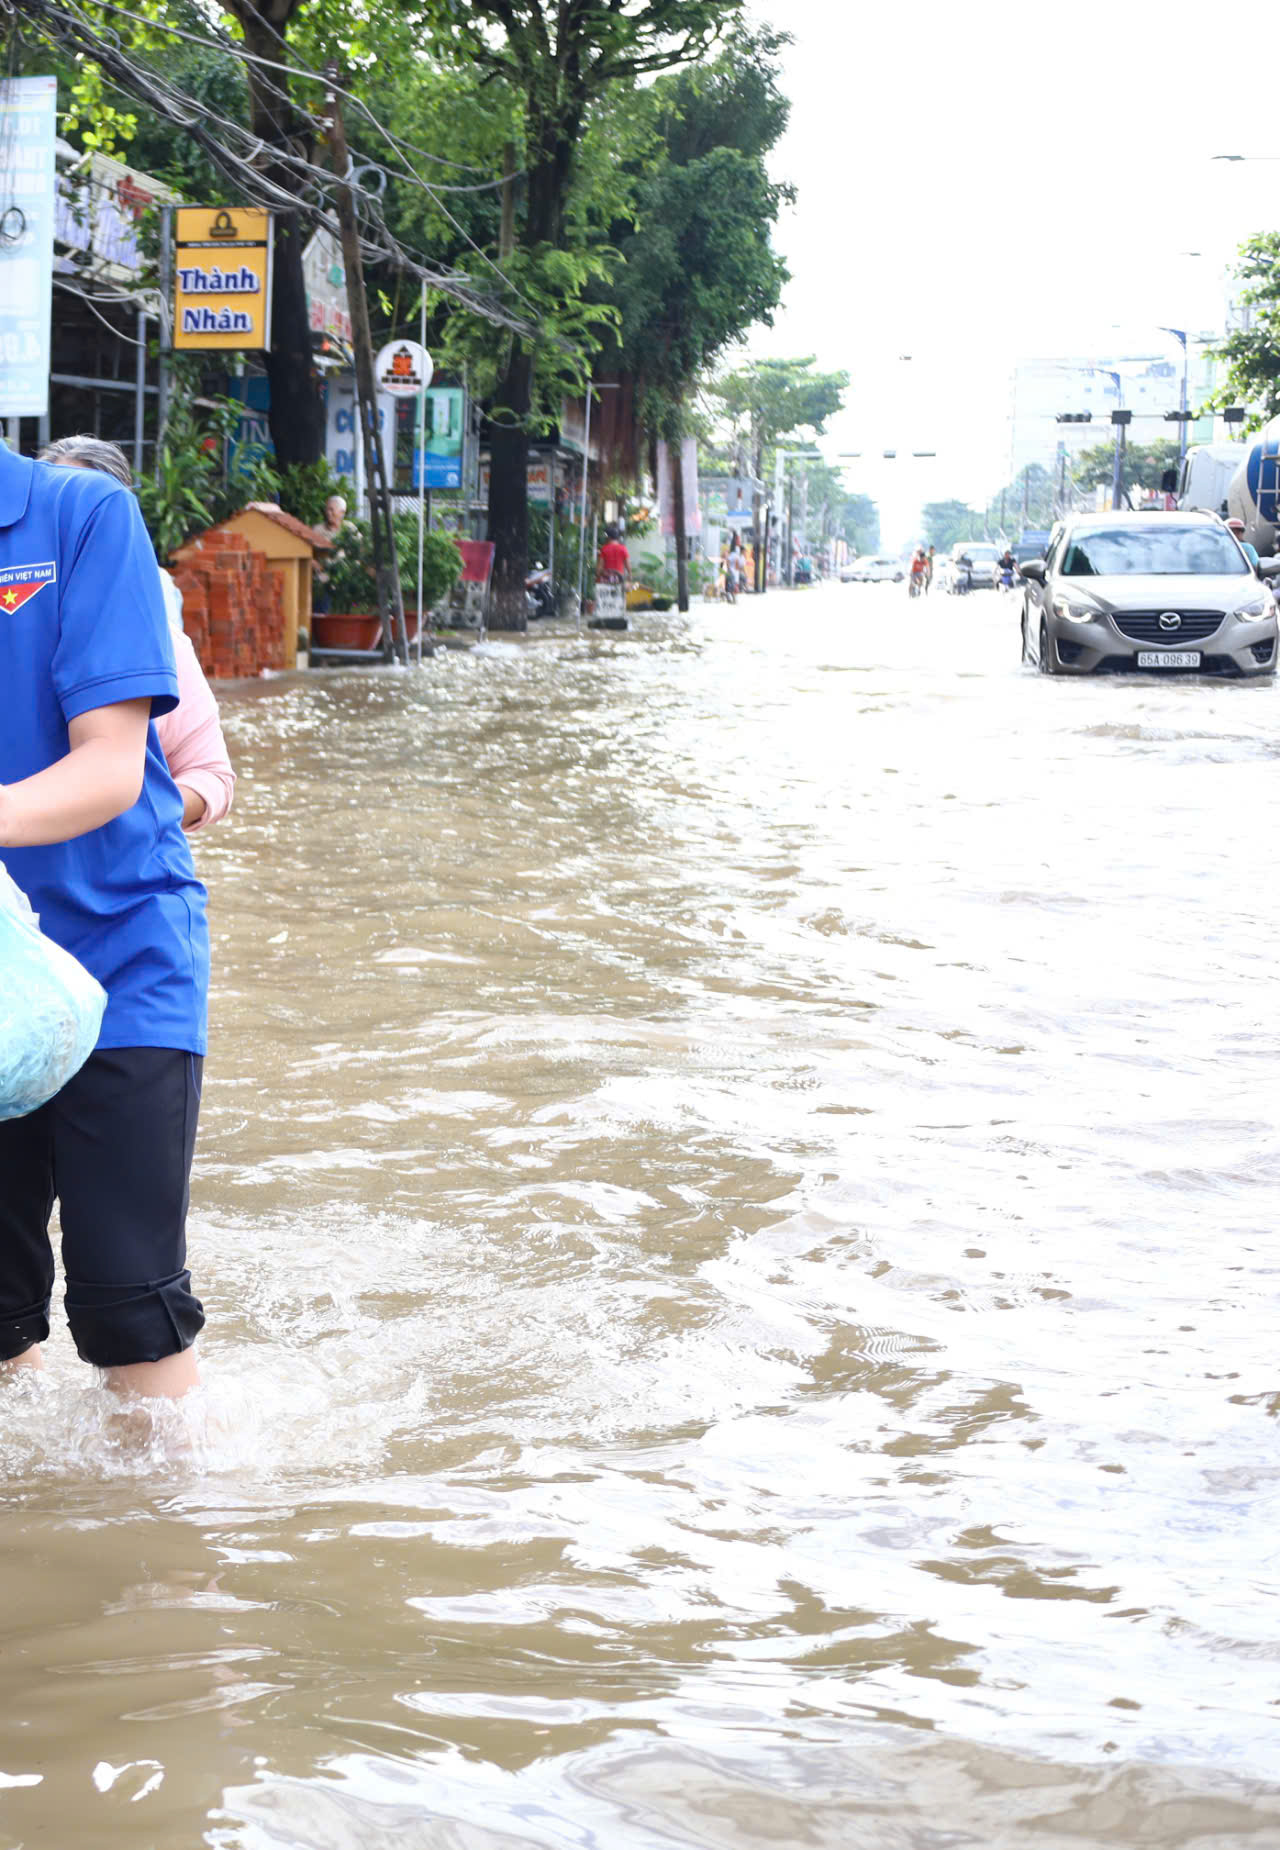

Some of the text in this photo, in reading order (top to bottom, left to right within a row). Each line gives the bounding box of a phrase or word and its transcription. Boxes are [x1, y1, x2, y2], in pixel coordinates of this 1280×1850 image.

[176, 266, 260, 293] Thành
[183, 306, 251, 332] Nhân
[15, 571, 32, 581] VIỆT
[34, 568, 52, 579] NAM
